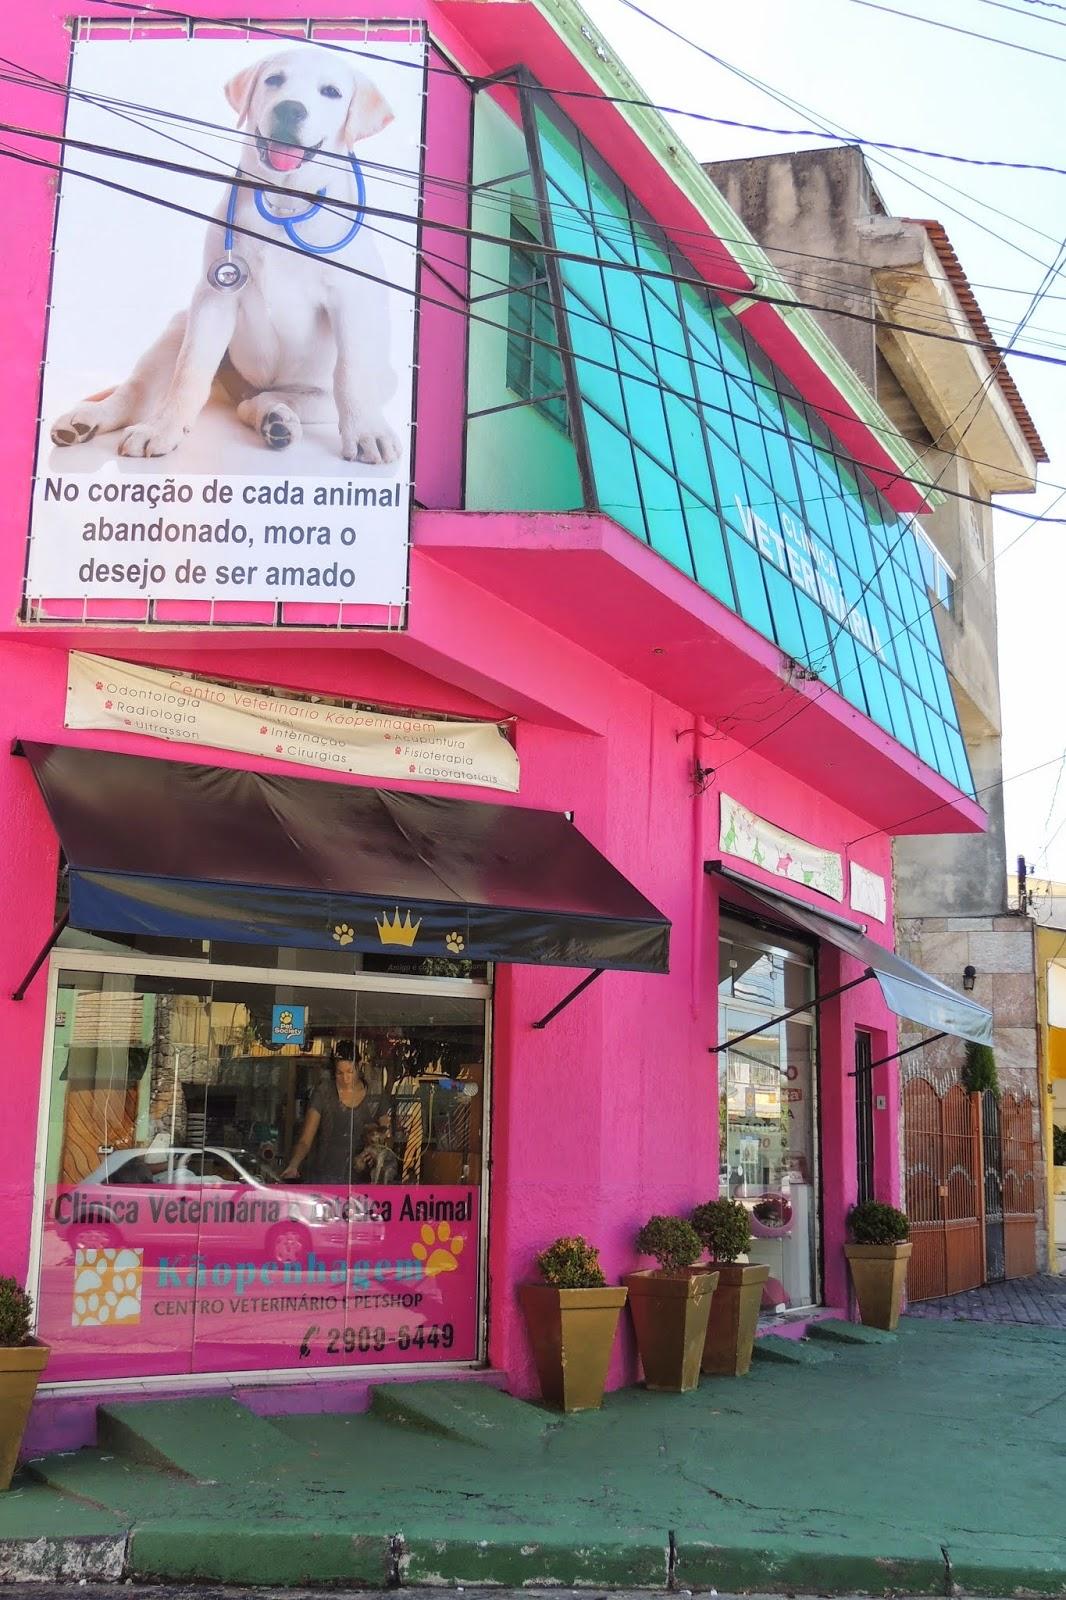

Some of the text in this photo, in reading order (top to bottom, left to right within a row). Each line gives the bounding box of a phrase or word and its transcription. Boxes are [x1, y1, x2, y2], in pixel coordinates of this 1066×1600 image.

[44, 477, 400, 508] No coração de cada animal
[82, 516, 356, 548] abandonado, mora o
[78, 558, 356, 589] desejo de ser amado
[106, 683, 200, 709] Odontologia
[169, 680, 225, 703] Centro
[117, 702, 196, 724] Radiologia
[395, 734, 465, 749] Acupuntura
[287, 746, 347, 764] Cirurgias
[404, 747, 473, 766] Fisioterapia
[418, 765, 498, 784] Laboratoriais
[274, 1027, 302, 1037] Society
[400, 1192, 473, 1221] Animal
[154, 1298, 224, 1316] CENTRO
[230, 1293, 337, 1314] VETERINÁRIO
[354, 1293, 423, 1310] PETSHOP
[326, 1323, 454, 1354] 2909-6449
